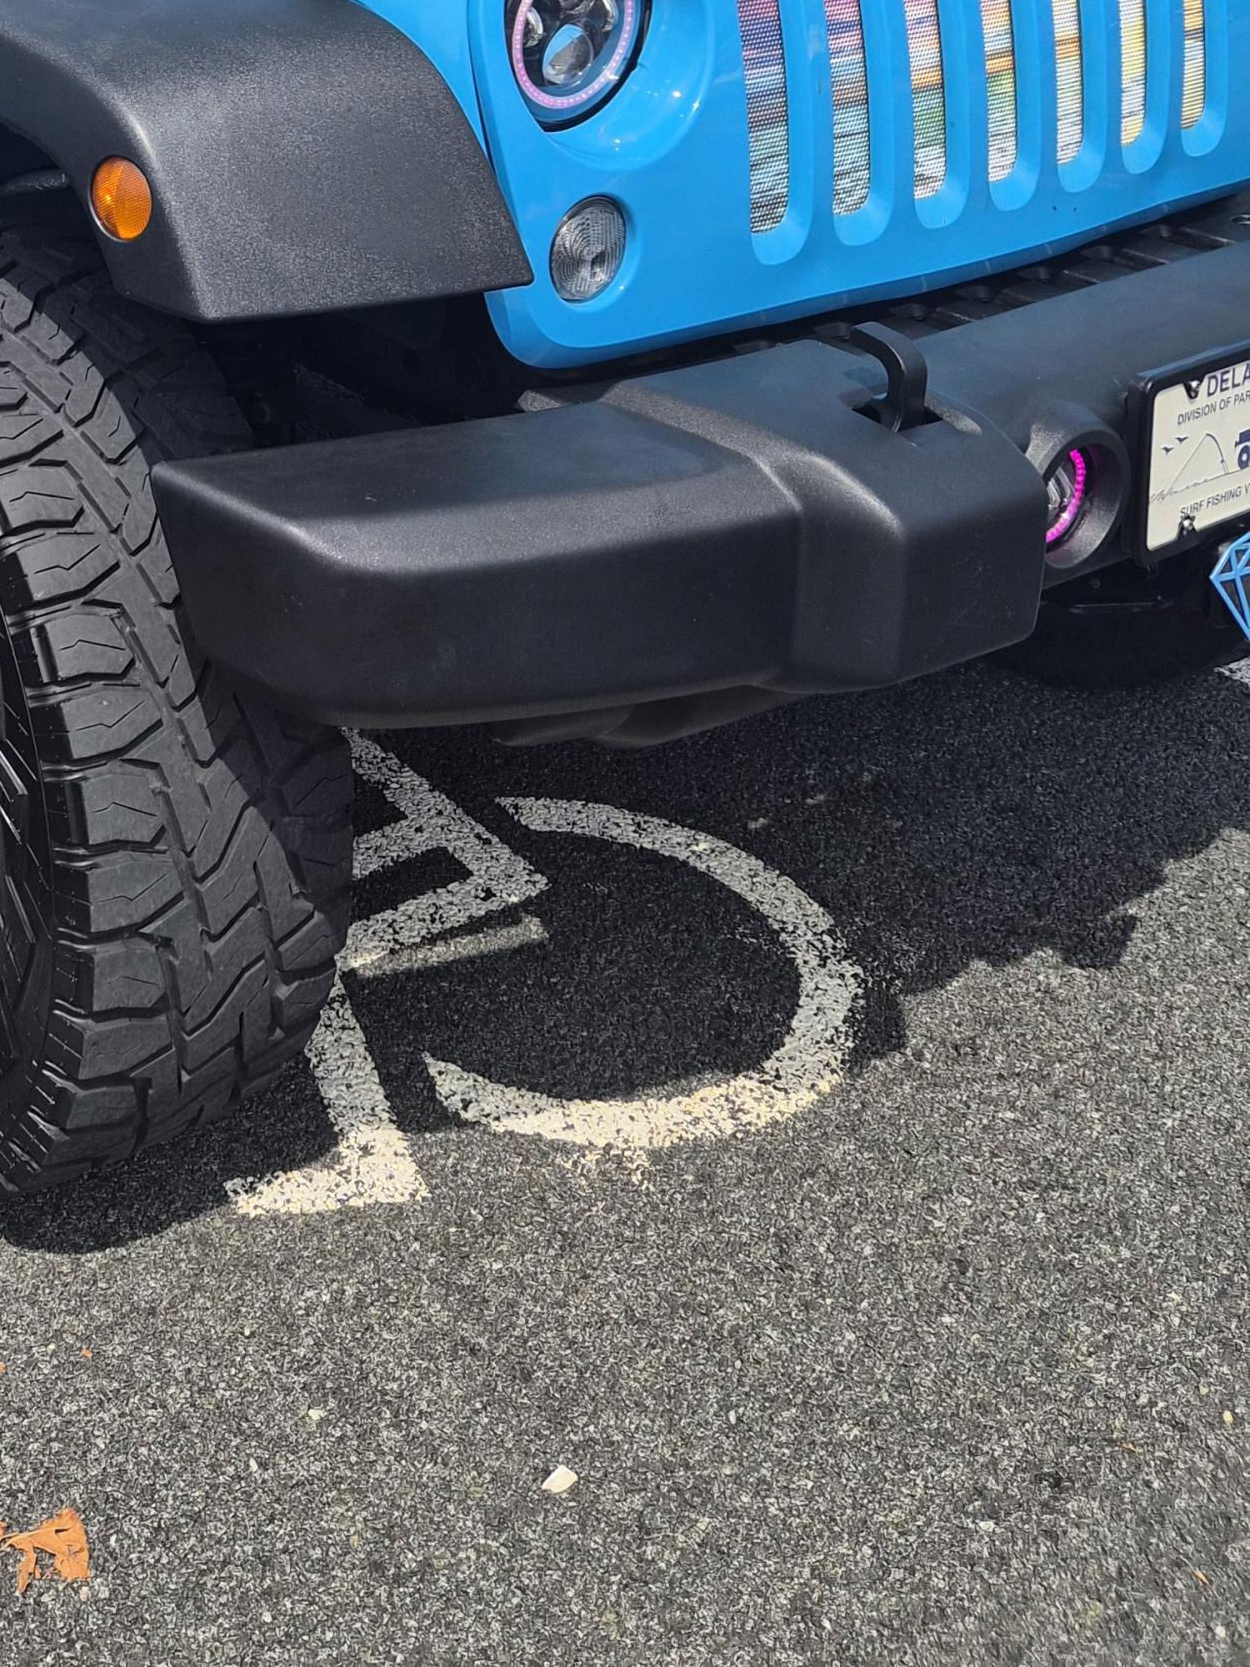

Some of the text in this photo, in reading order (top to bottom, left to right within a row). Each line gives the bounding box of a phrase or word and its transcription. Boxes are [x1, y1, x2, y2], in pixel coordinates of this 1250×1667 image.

[1177, 400, 1218, 426] DIVISION
[1219, 397, 1231, 412] OF
[1179, 500, 1205, 518] SURF
[1206, 485, 1243, 511] FISHING
